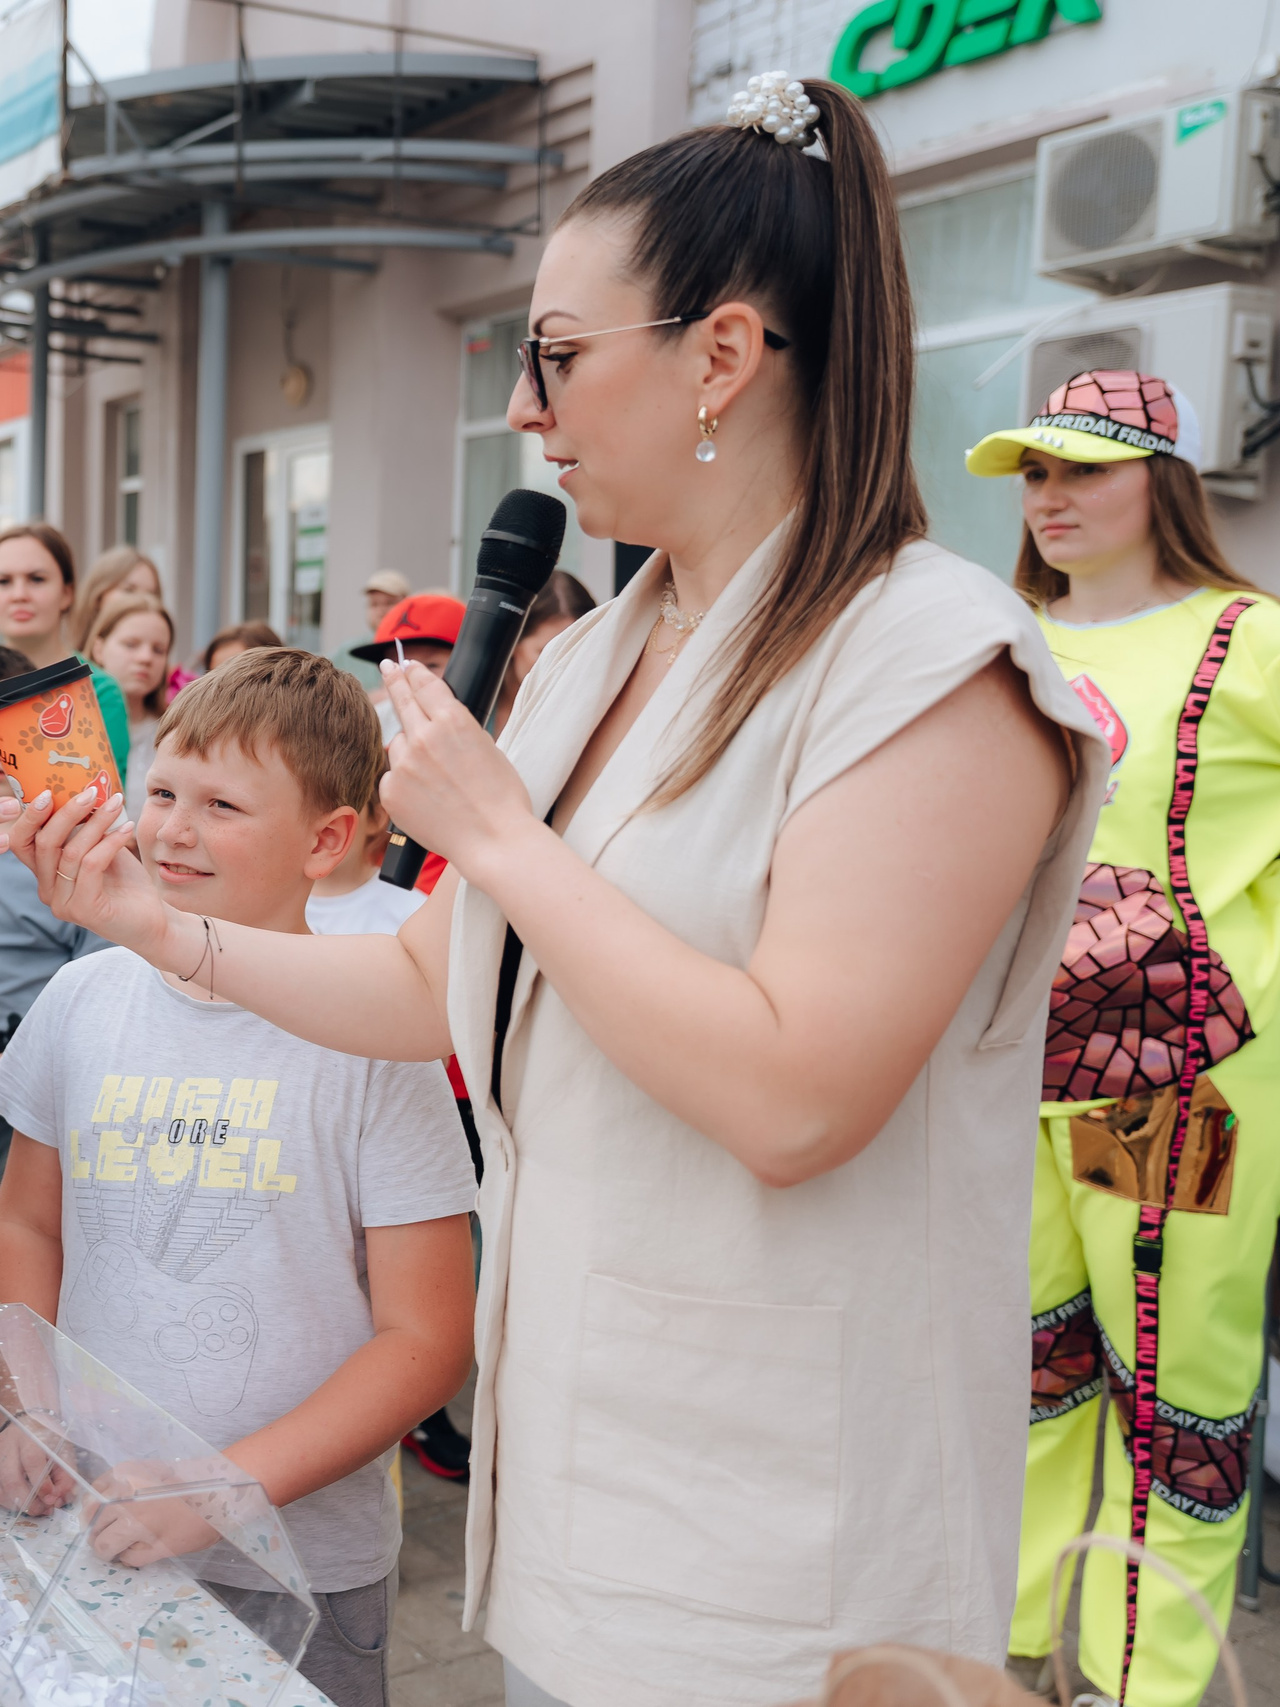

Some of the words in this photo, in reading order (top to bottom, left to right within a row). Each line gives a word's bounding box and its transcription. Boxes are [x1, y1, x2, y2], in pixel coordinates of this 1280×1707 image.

[1051, 414, 1119, 438] FRIDAY
[1117, 427, 1176, 454] FRIDAY
[91, 1074, 279, 1130] HIGH
[71, 1130, 297, 1193] LEVEL
